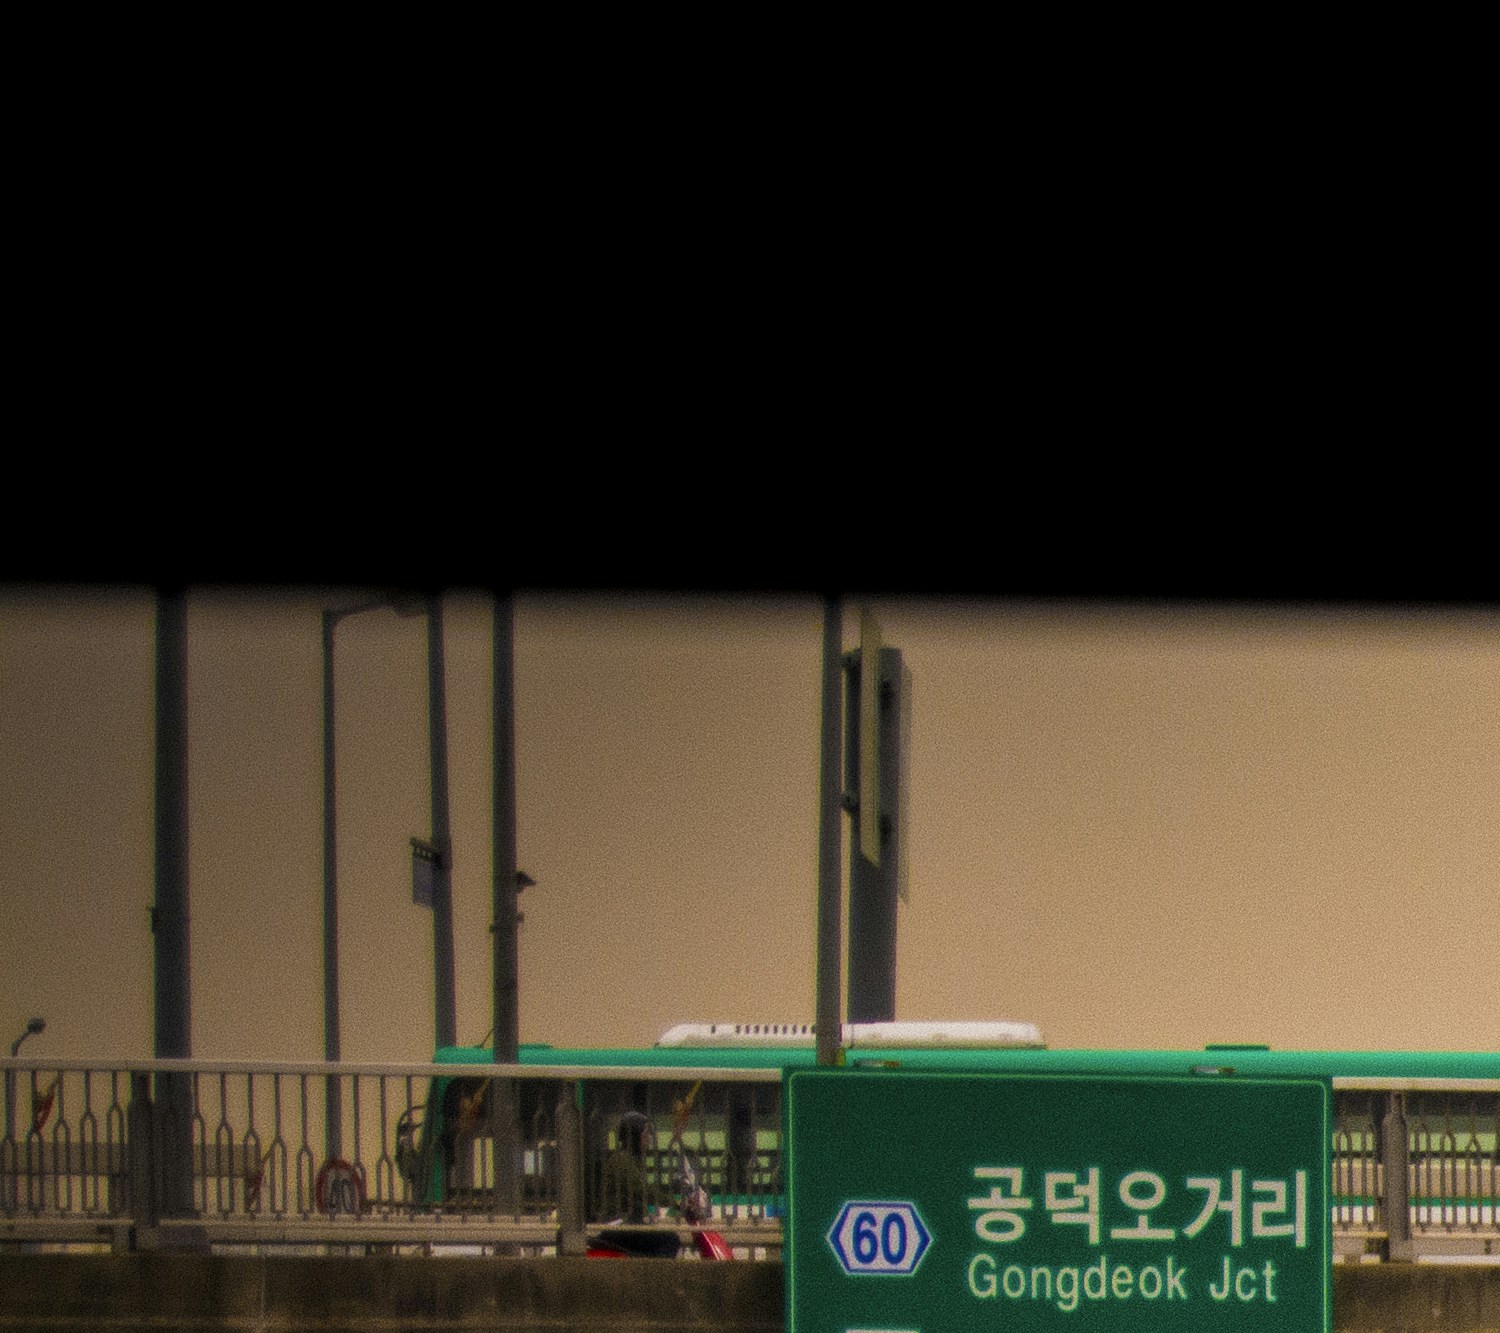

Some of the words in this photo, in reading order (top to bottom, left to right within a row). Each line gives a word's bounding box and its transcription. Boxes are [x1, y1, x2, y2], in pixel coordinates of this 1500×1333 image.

[968, 1167, 1306, 1247] 공덕오거리
[851, 1211, 907, 1265] 60
[968, 1253, 1187, 1311] Gongdeok
[1210, 1256, 1276, 1302] Jct
